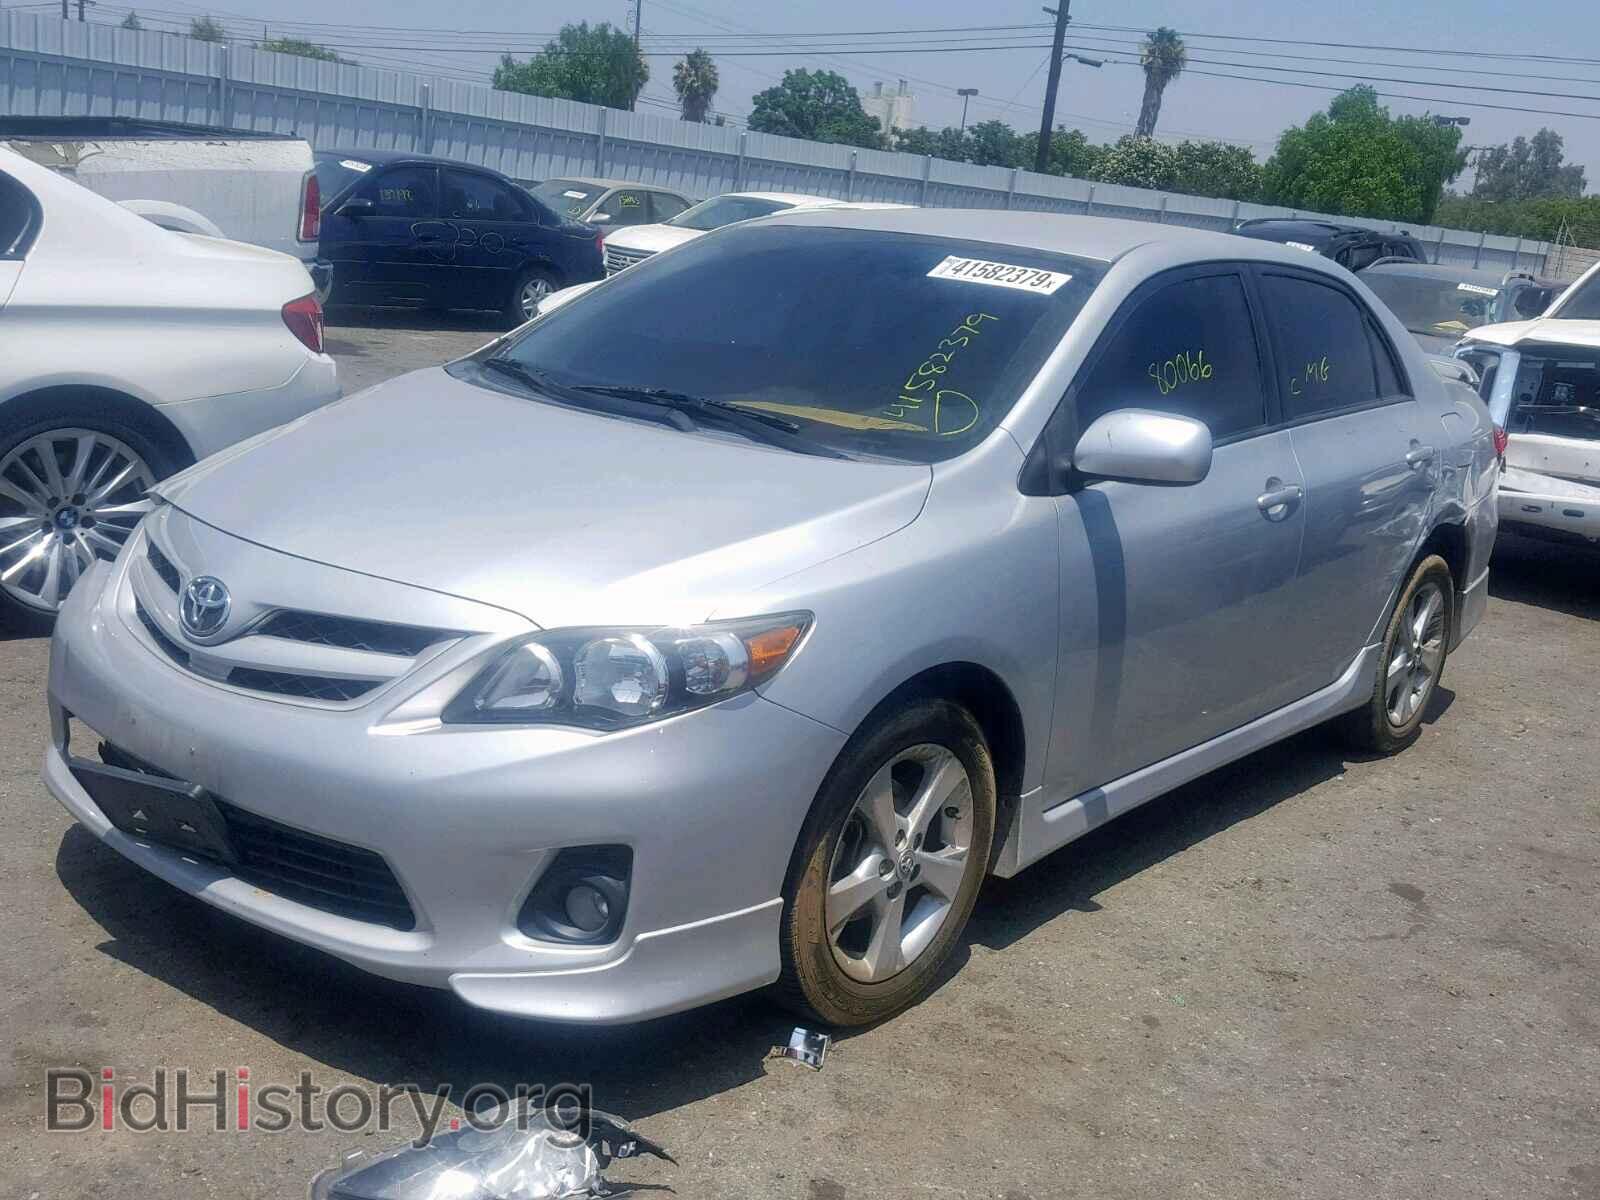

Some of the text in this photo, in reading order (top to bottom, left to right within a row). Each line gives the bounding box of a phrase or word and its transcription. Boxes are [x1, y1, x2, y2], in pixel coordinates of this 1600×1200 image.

[952, 261, 1051, 287] 41582379
[883, 313, 999, 417] 41582379
[1148, 350, 1212, 394] 80066
